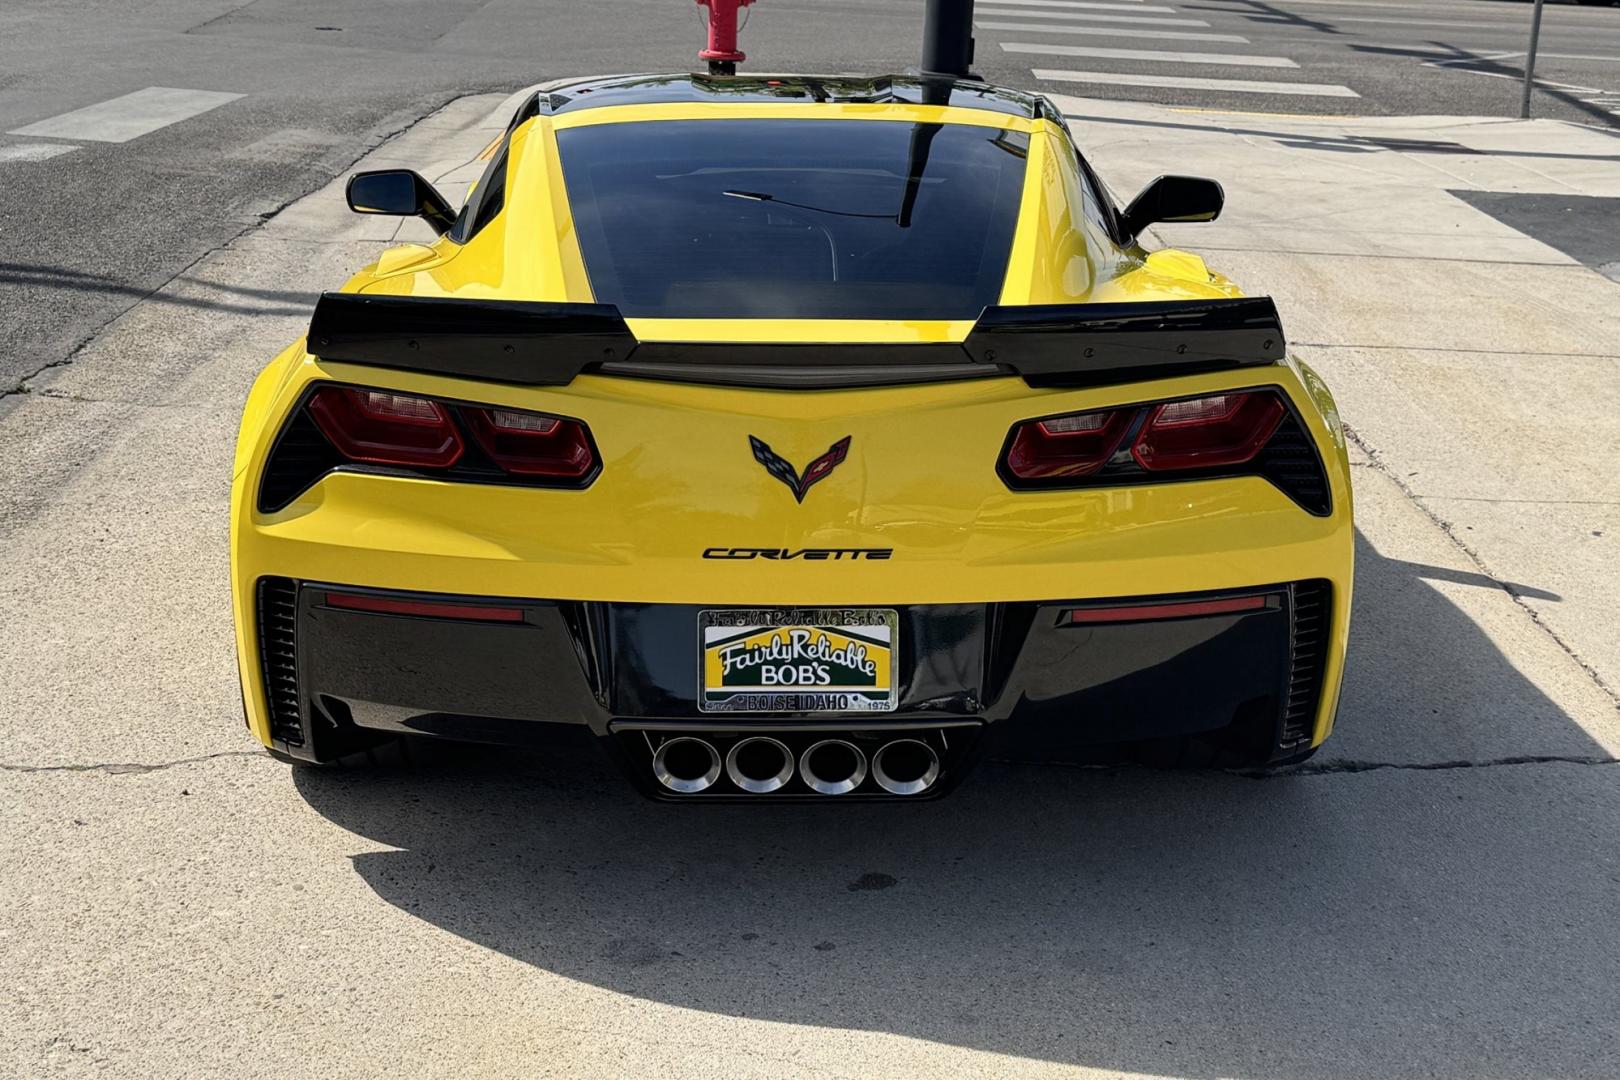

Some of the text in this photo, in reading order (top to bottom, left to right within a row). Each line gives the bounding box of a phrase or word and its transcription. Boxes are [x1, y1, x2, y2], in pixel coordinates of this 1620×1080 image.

[702, 548, 894, 560] CORVETTE
[719, 629, 876, 676] Fairly Reliable
[761, 662, 831, 685] BOB'S
[746, 695, 848, 711] BOISE IDAHO
[868, 702, 890, 711] 1975
